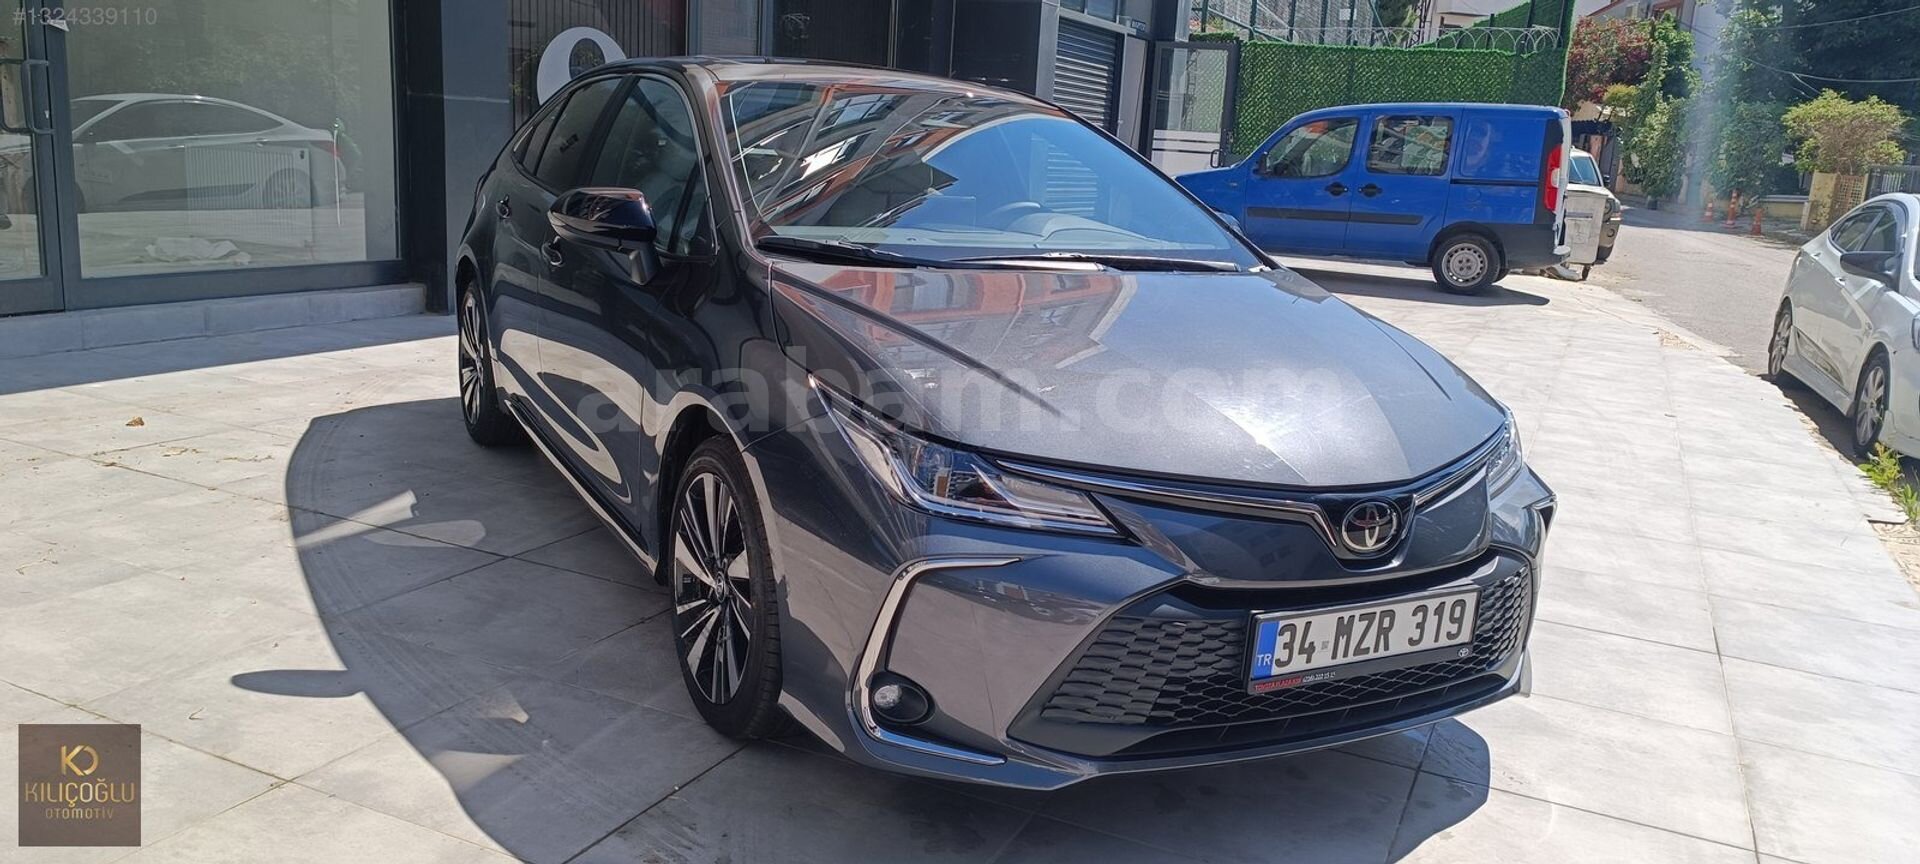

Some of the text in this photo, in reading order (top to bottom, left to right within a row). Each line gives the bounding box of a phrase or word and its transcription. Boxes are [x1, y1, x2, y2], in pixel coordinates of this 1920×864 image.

[1274, 599, 1466, 668] 34 MZR 319
[1256, 653, 1273, 667] TR
